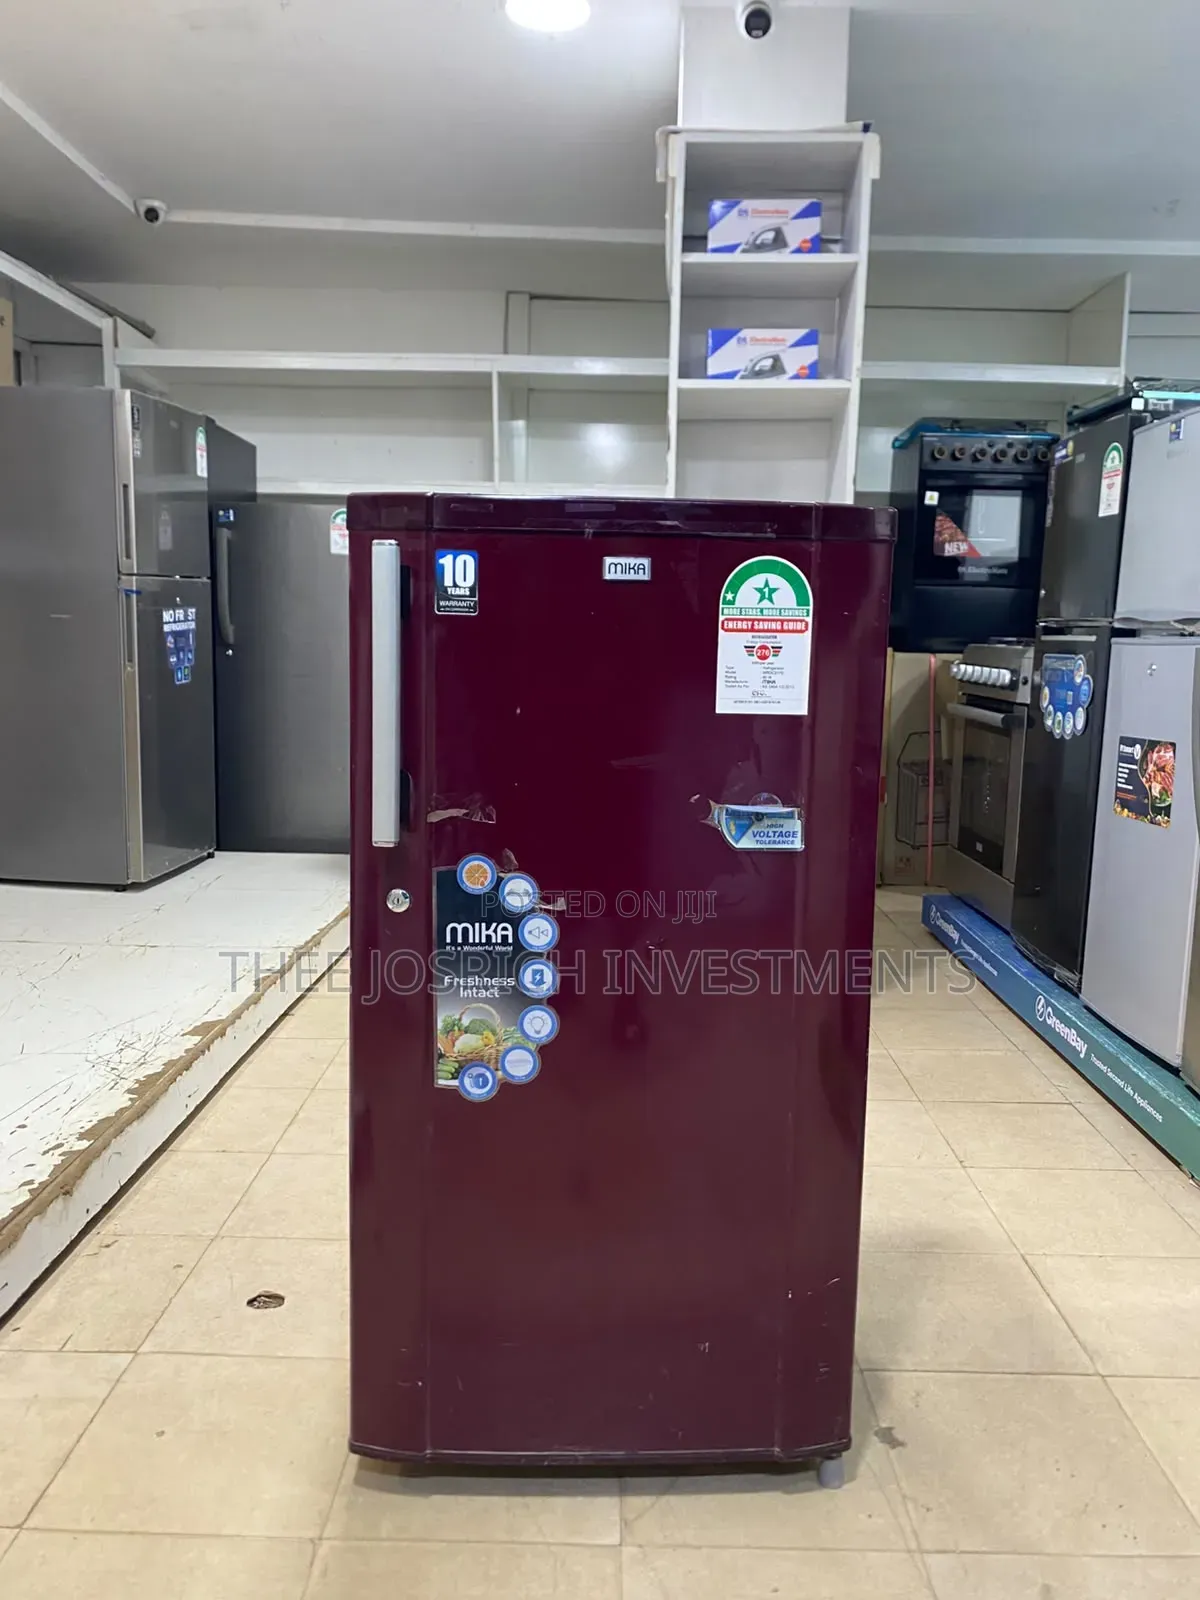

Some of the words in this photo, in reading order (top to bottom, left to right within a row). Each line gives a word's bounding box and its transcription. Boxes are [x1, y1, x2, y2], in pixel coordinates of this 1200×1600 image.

[944, 541, 969, 557] NEW
[438, 553, 475, 587] 10
[608, 562, 646, 575] MIKA
[446, 587, 470, 596] YEARS
[763, 586, 769, 598] 1
[163, 610, 174, 622] NO
[723, 608, 740, 616] MORE
[763, 608, 780, 616] MORE
[781, 609, 808, 617] SAVINGS
[723, 620, 752, 630] ENERGY
[753, 621, 782, 630] SAVING
[783, 622, 806, 631] GUIDE
[752, 830, 799, 838] VOLTAGE
[445, 922, 513, 943] MIKA
[444, 975, 516, 986] Freshness
[460, 986, 500, 998] Intact
[1045, 1006, 1088, 1059] GreenBay
[1105, 1067, 1126, 1089] Second
[1123, 1084, 1135, 1098] Life
[1133, 1092, 1164, 1123] Appliances
